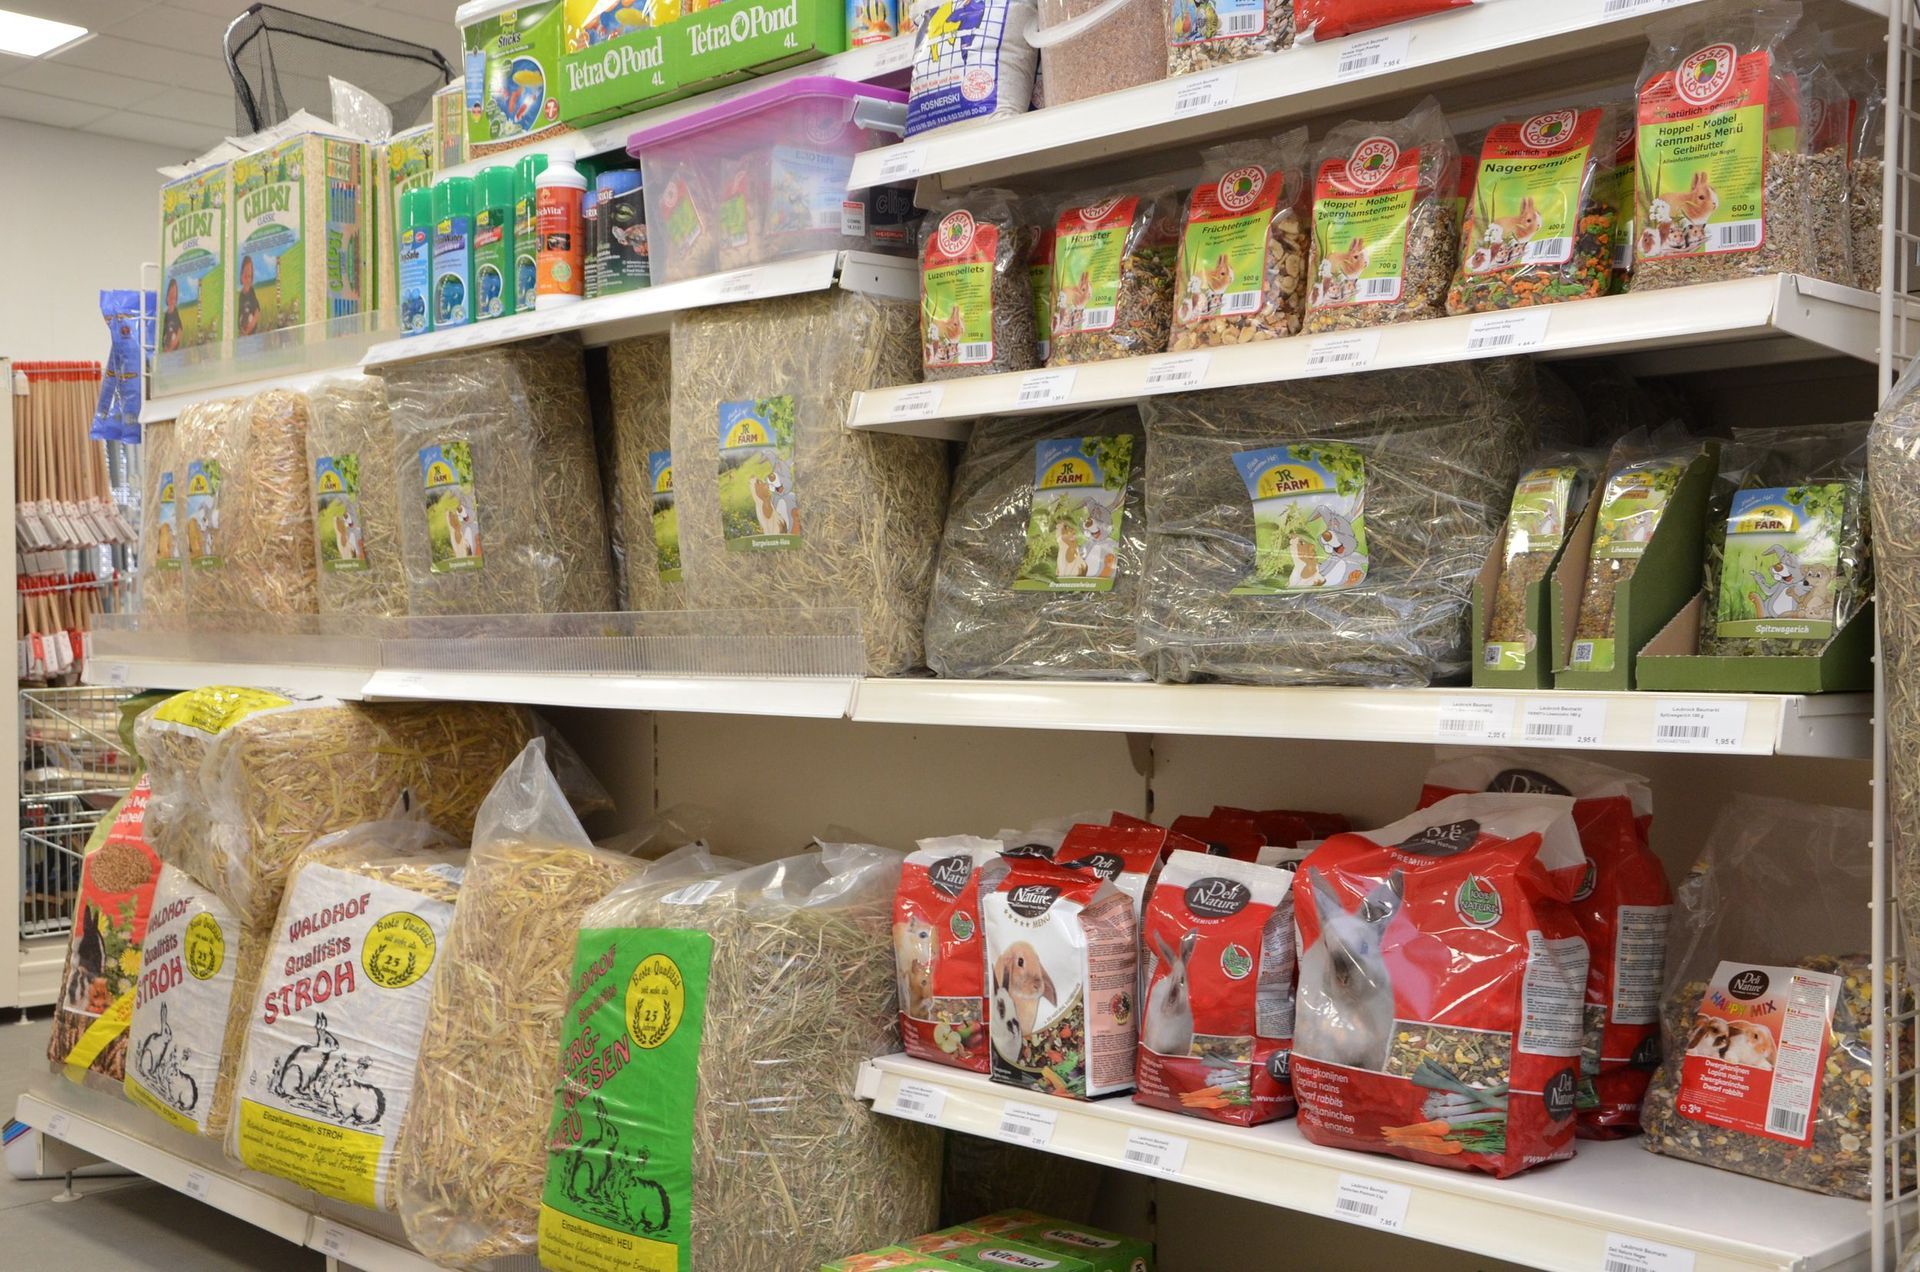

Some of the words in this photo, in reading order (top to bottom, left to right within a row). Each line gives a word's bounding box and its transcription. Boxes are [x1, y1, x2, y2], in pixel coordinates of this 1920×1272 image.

[784, 31, 798, 49] 4L
[1687, 49, 1729, 70] ROSEN
[651, 71, 665, 87] 4L
[920, 93, 960, 112] ROSNERSKI
[1666, 106, 1703, 119] natürlich
[1659, 123, 1694, 136] Hoppel
[1703, 113, 1737, 129] Mobbel
[1655, 131, 1712, 148] Rennmaus
[1714, 122, 1744, 137] Menü
[1358, 143, 1393, 162] ROSEN
[1673, 140, 1724, 156] Gerbilfutter
[1484, 152, 1582, 175] Nagergemüse
[1226, 168, 1261, 185] ROSEN
[243, 185, 292, 223] CHIPSI
[1323, 199, 1357, 210] Hoppel
[1366, 194, 1399, 207] Mobbel
[1731, 203, 1748, 212] 600
[1749, 205, 1755, 213] g
[1318, 200, 1407, 221] Zwerghamstermenü
[171, 212, 214, 248] CHIPSI
[1070, 231, 1112, 244] Hamster
[928, 264, 985, 281] Luzernepellets
[737, 434, 758, 444] FARM
[1060, 462, 1074, 476] JR
[1275, 469, 1294, 482] JR
[1055, 473, 1083, 484] FARM
[1275, 478, 1310, 493] FARM
[1754, 519, 1788, 531] FARM
[1577, 736, 1592, 744] 2,95
[1715, 738, 1729, 746] 1,95
[1091, 855, 1115, 869] Deli
[1391, 851, 1436, 867] PREMIUM
[1013, 887, 1053, 905] Nature
[1206, 880, 1238, 900] Deli
[1192, 887, 1239, 910] Nature
[288, 893, 371, 943] WALDHOF
[144, 933, 178, 967] Qualitäts
[285, 936, 352, 976] Qualitäts
[384, 954, 401, 967] 25
[136, 955, 184, 1010] STROH
[1733, 978, 1763, 993] Nature
[1743, 972, 1761, 985] Deli
[263, 960, 355, 1025] STROH
[1711, 991, 1747, 1018] HAPPY
[1750, 999, 1777, 1018] MIX
[645, 1009, 658, 1022] 25
[1295, 1062, 1349, 1084] Dwergkonijnen
[1708, 1068, 1727, 1079] Lapins
[1319, 1082, 1340, 1094] nains
[1702, 1082, 1722, 1093] Dwarf
[1722, 1088, 1744, 1098] rabbits
[1317, 1093, 1344, 1108] rabbits
[316, 1127, 343, 1141] STROH
[1324, 1121, 1354, 1135] enanos
[616, 1237, 633, 1251] HEU
[987, 1250, 1044, 1268] kitekat
